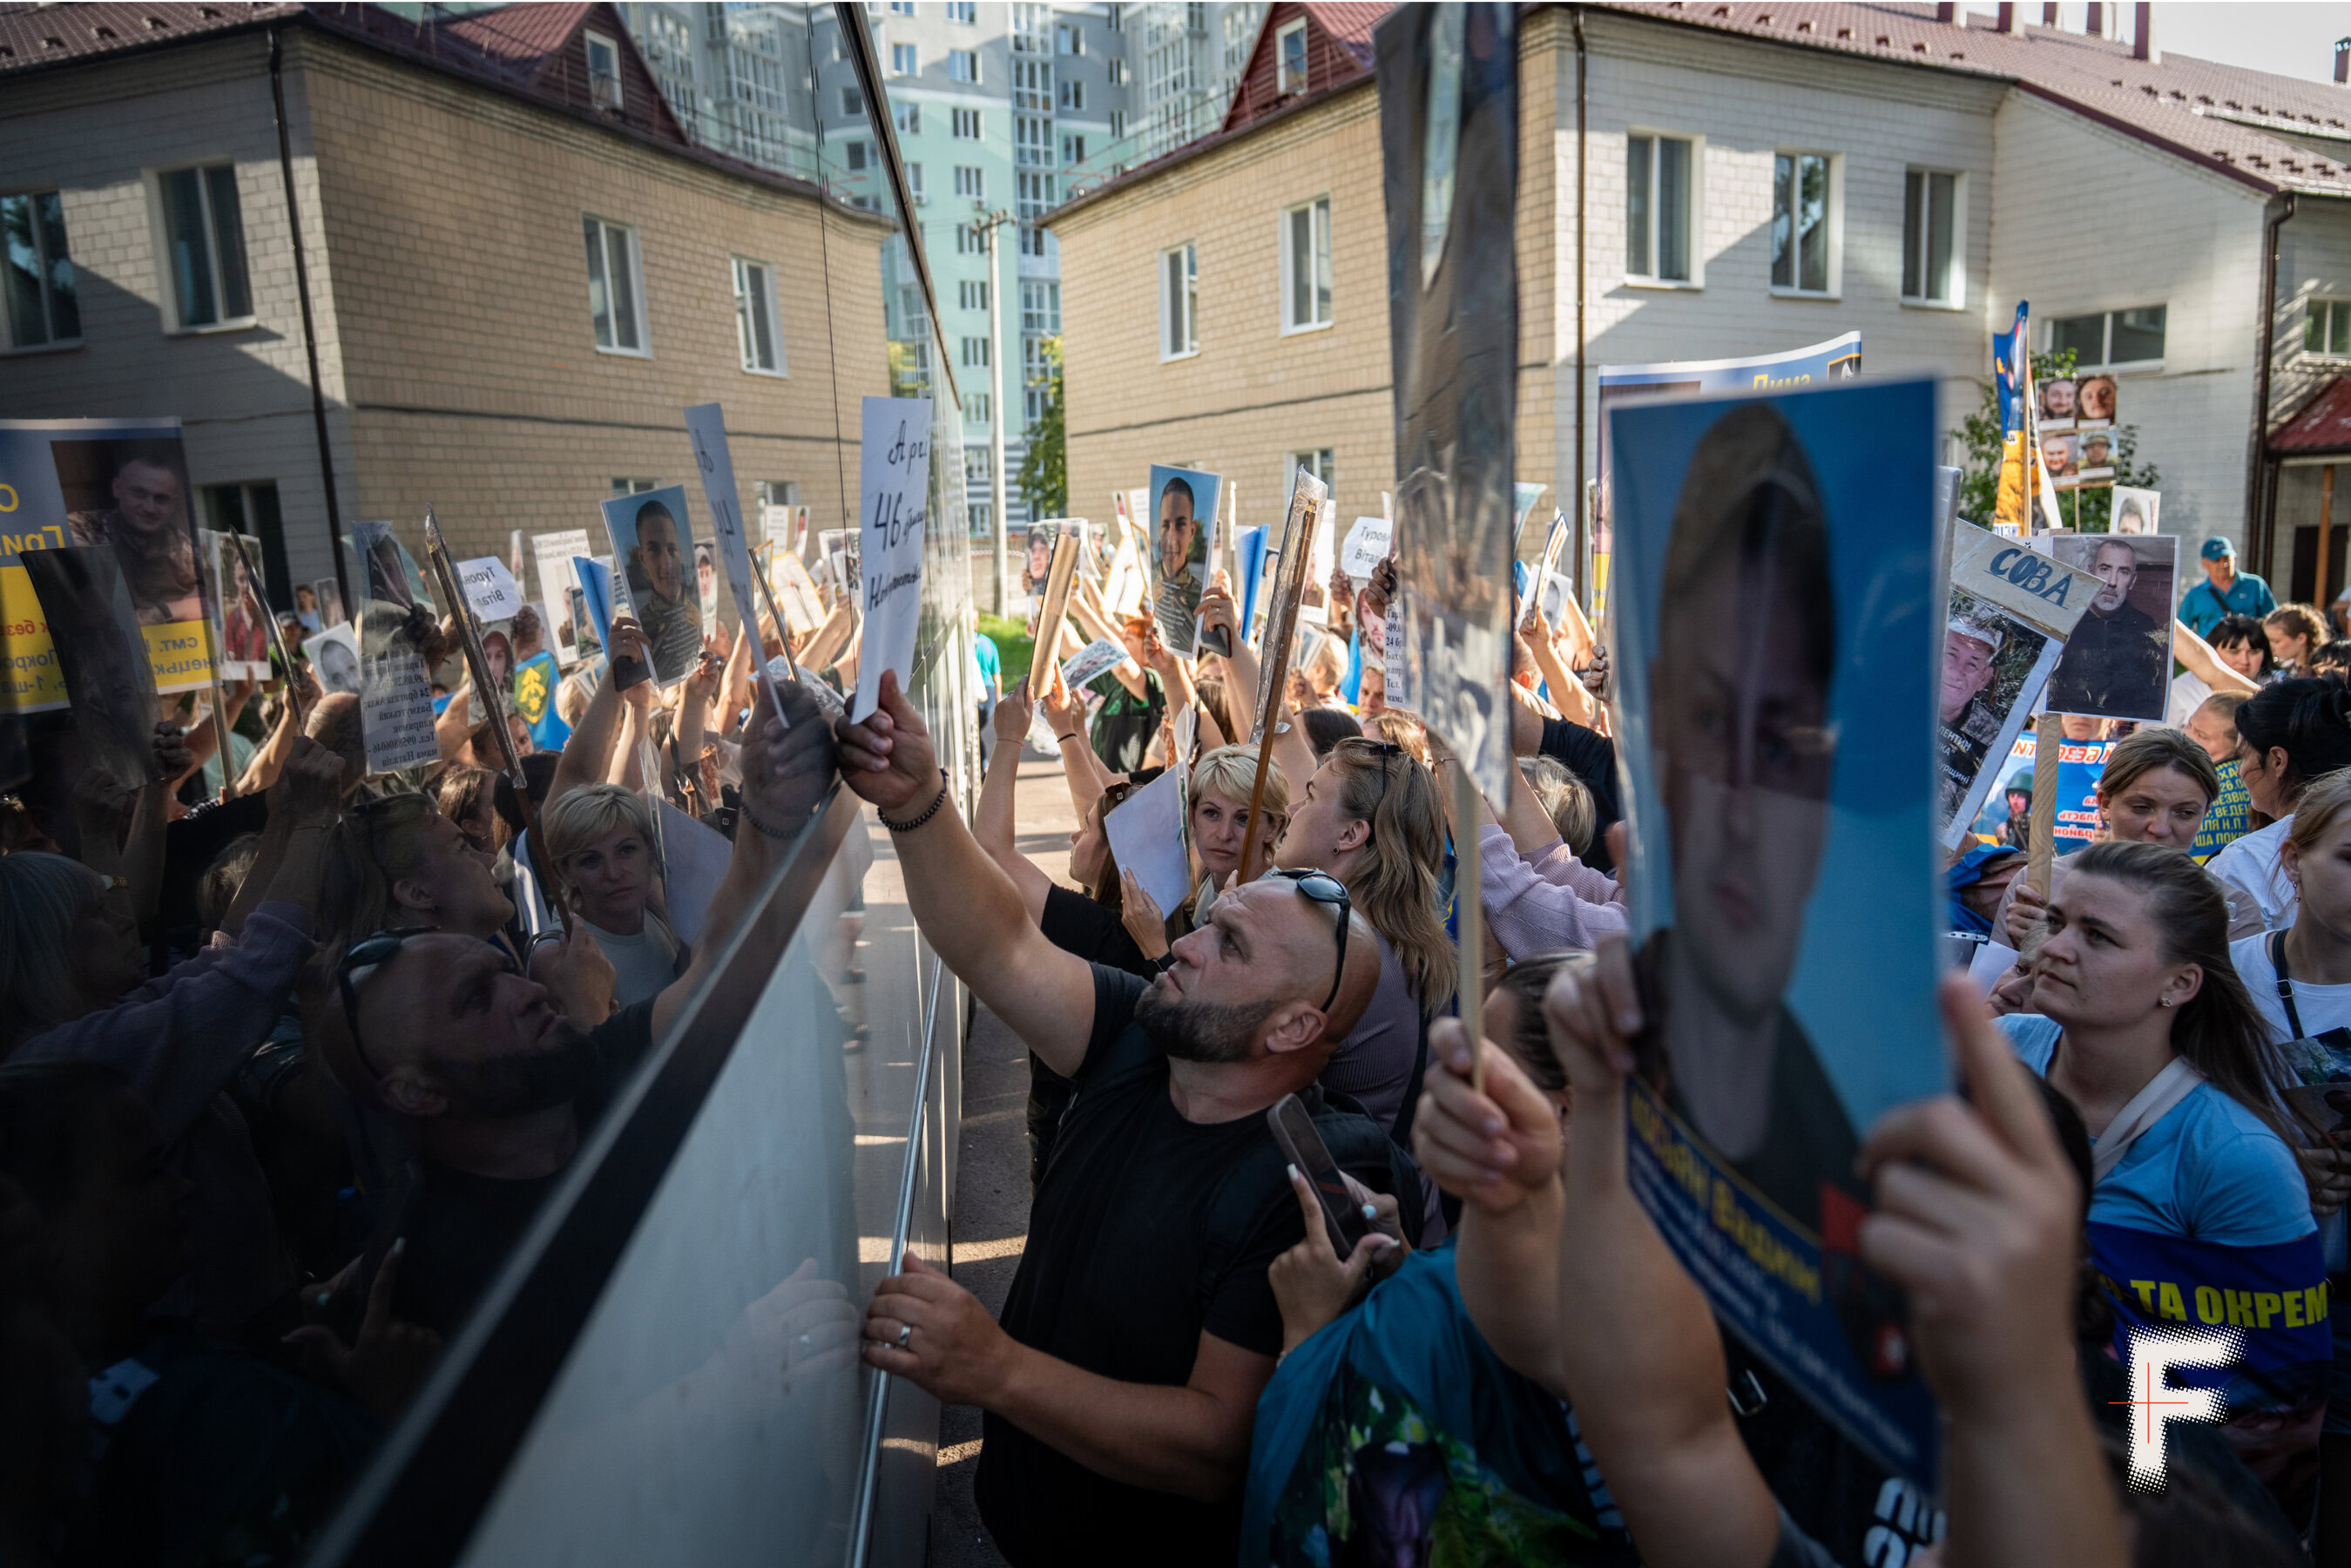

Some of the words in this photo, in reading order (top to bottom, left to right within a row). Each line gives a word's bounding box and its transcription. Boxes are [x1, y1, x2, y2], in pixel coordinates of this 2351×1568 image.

[874, 491, 902, 551] 46
[1990, 548, 2073, 607] СОВА
[1386, 637, 1395, 645] 24
[1939, 726, 1972, 752] ЛЕНТИН
[2130, 1279, 2188, 1322] ТА
[2194, 1281, 2328, 1329] ОКРЕМ
